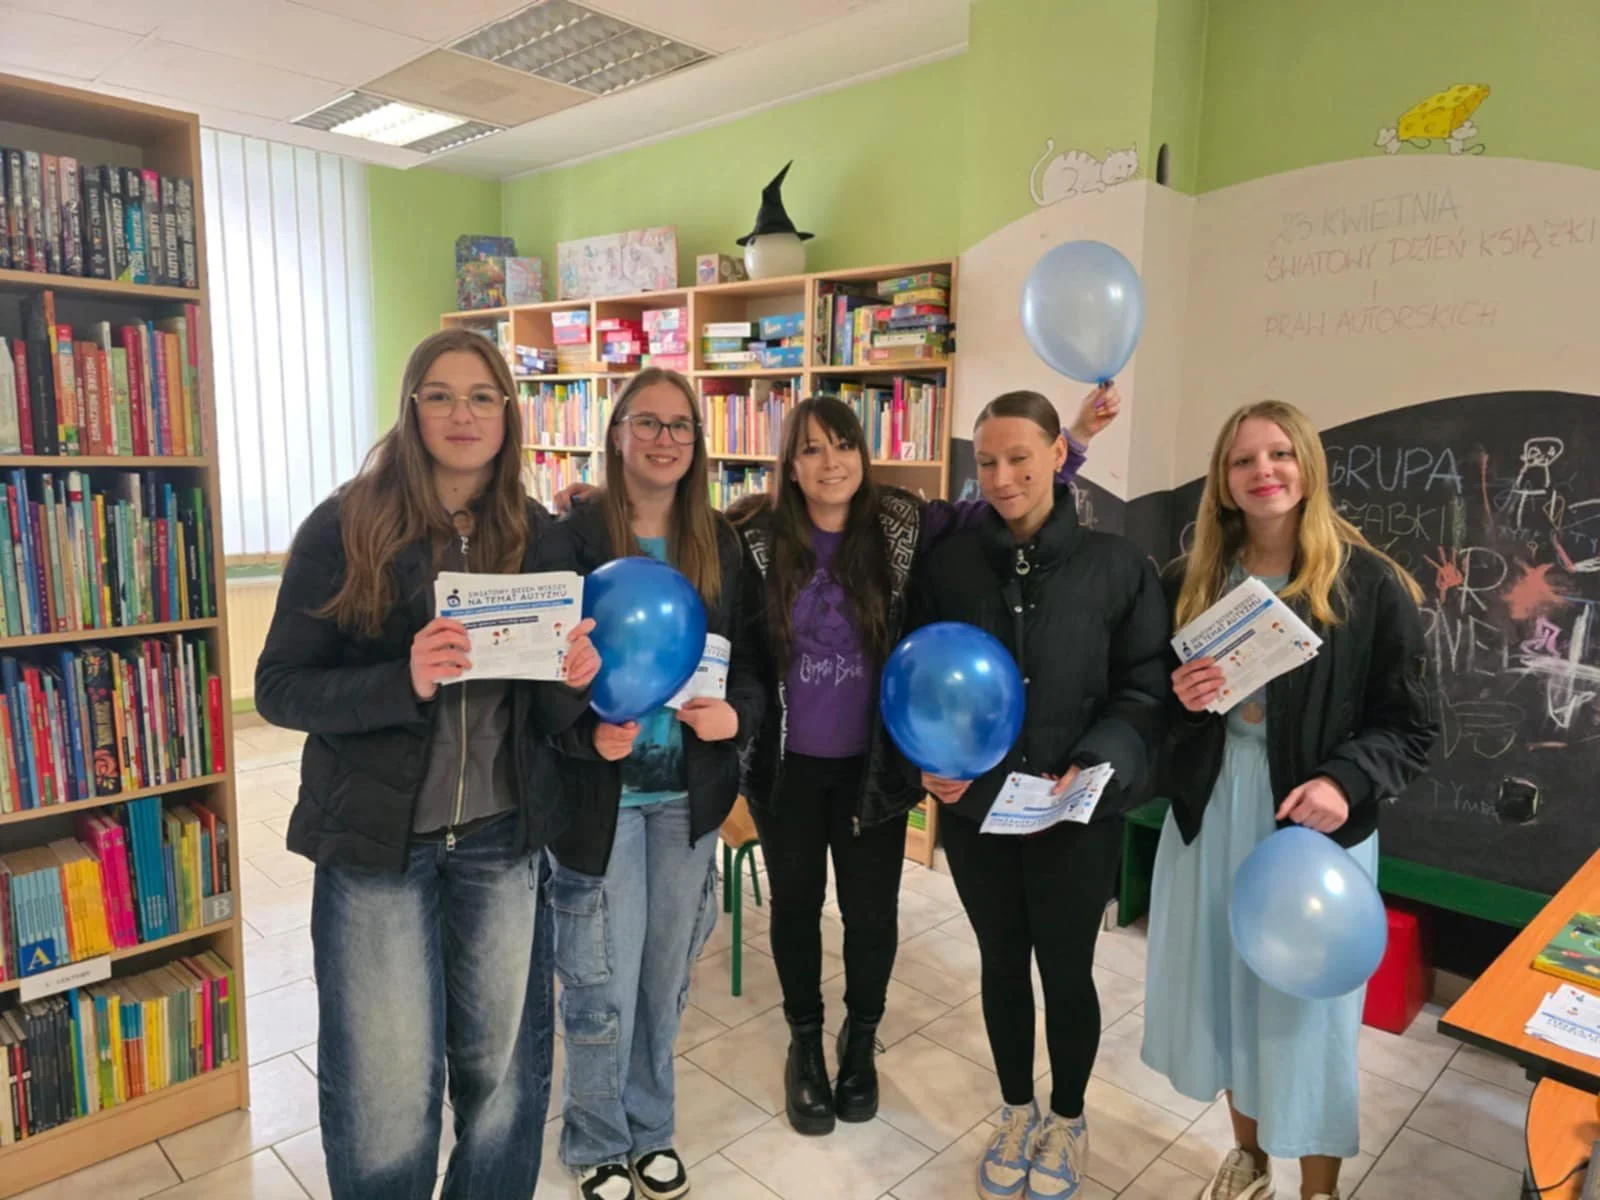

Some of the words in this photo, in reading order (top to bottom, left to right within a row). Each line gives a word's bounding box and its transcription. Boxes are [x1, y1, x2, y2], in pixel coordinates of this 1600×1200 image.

[1322, 184, 1464, 237] KWIETNIA
[1387, 229, 1467, 265] DZIEŃ
[486, 594, 517, 605] TEMAT
[520, 590, 568, 601] AUTYZMU
[212, 899, 232, 919] B
[27, 945, 52, 972] A
